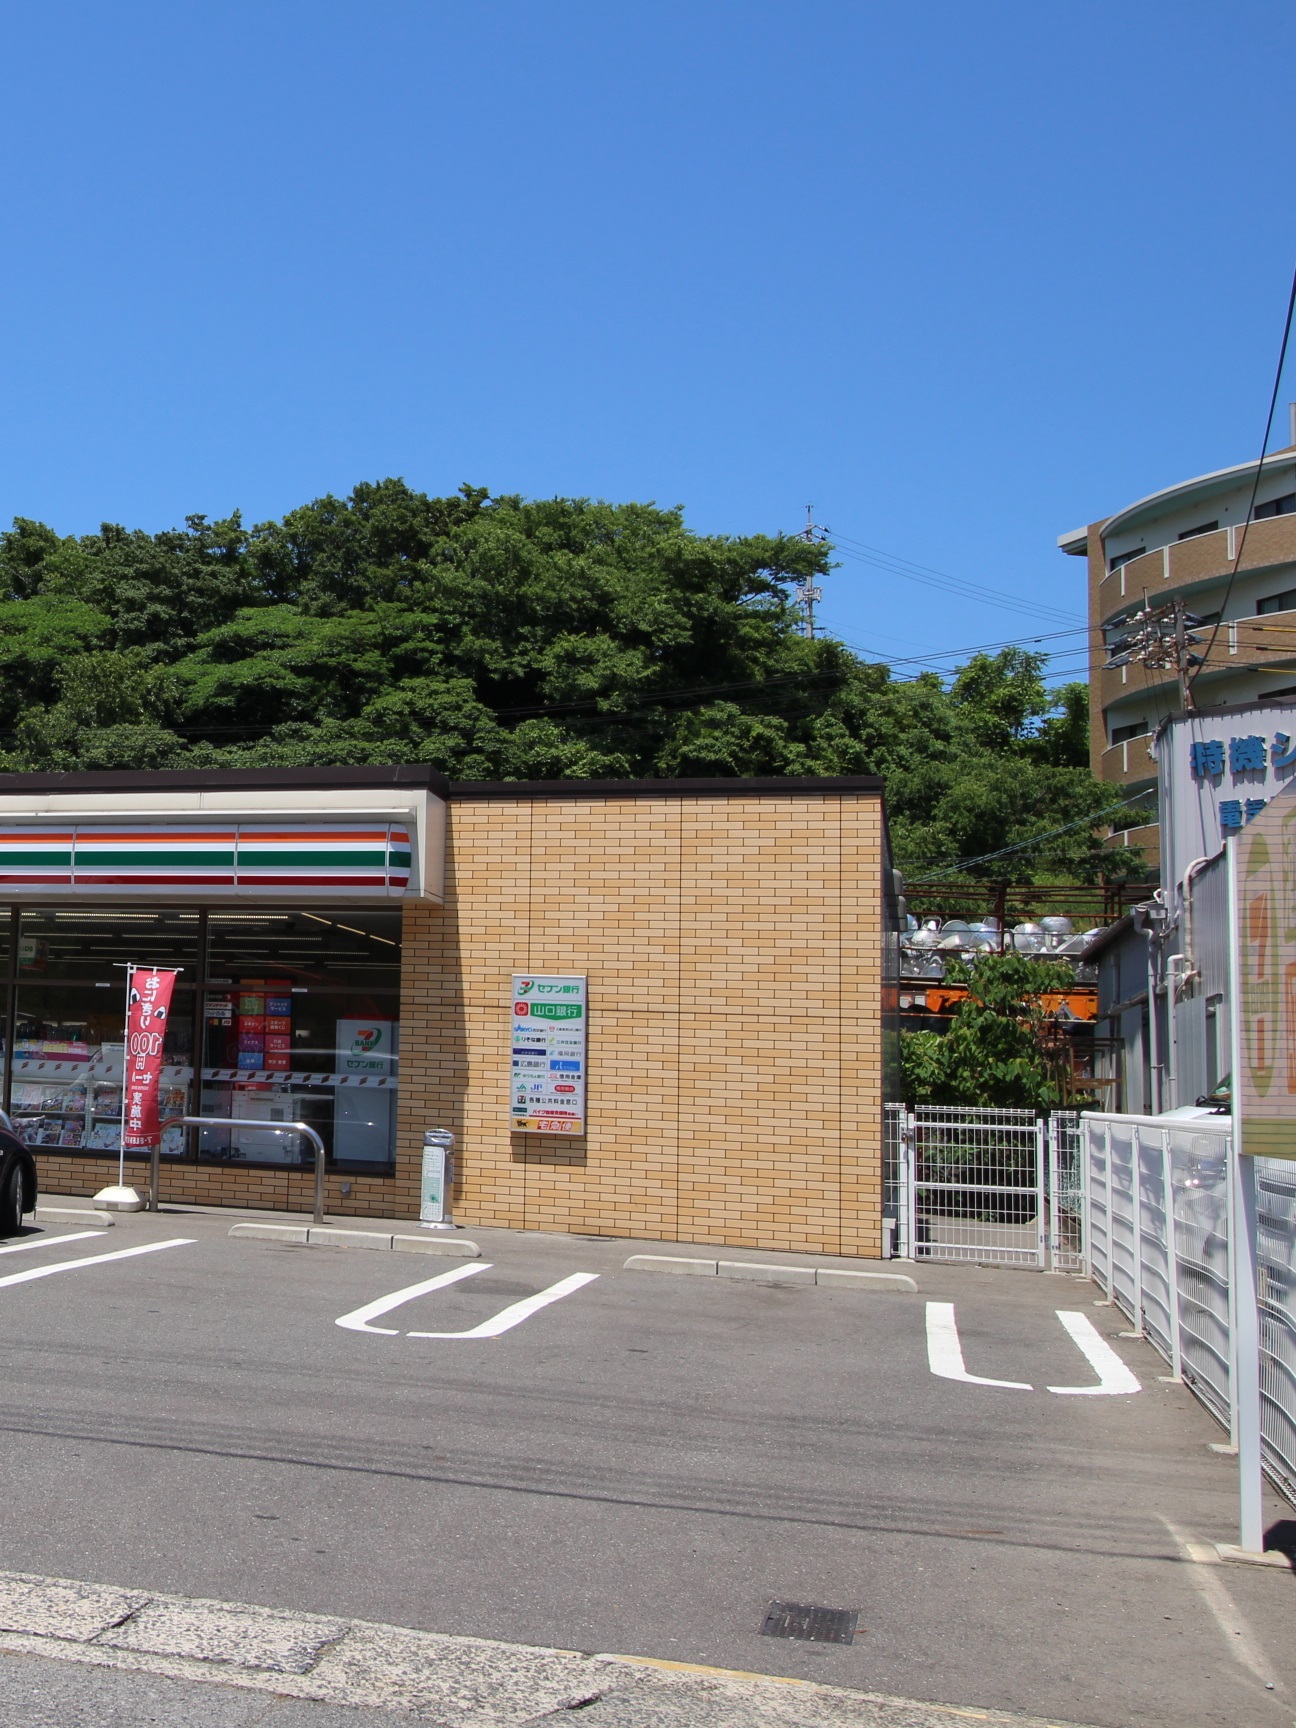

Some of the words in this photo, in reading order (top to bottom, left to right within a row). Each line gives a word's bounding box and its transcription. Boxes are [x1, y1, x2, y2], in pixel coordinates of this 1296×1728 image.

[537, 983, 580, 994] セブン銀行
[534, 1004, 578, 1017] 山口銀行
[346, 1060, 384, 1069] セブン銀行
[520, 1060, 546, 1069] 広島銀行
[529, 1097, 578, 1105] 各種公共料金窓口
[538, 1120, 572, 1131] 宅急便
